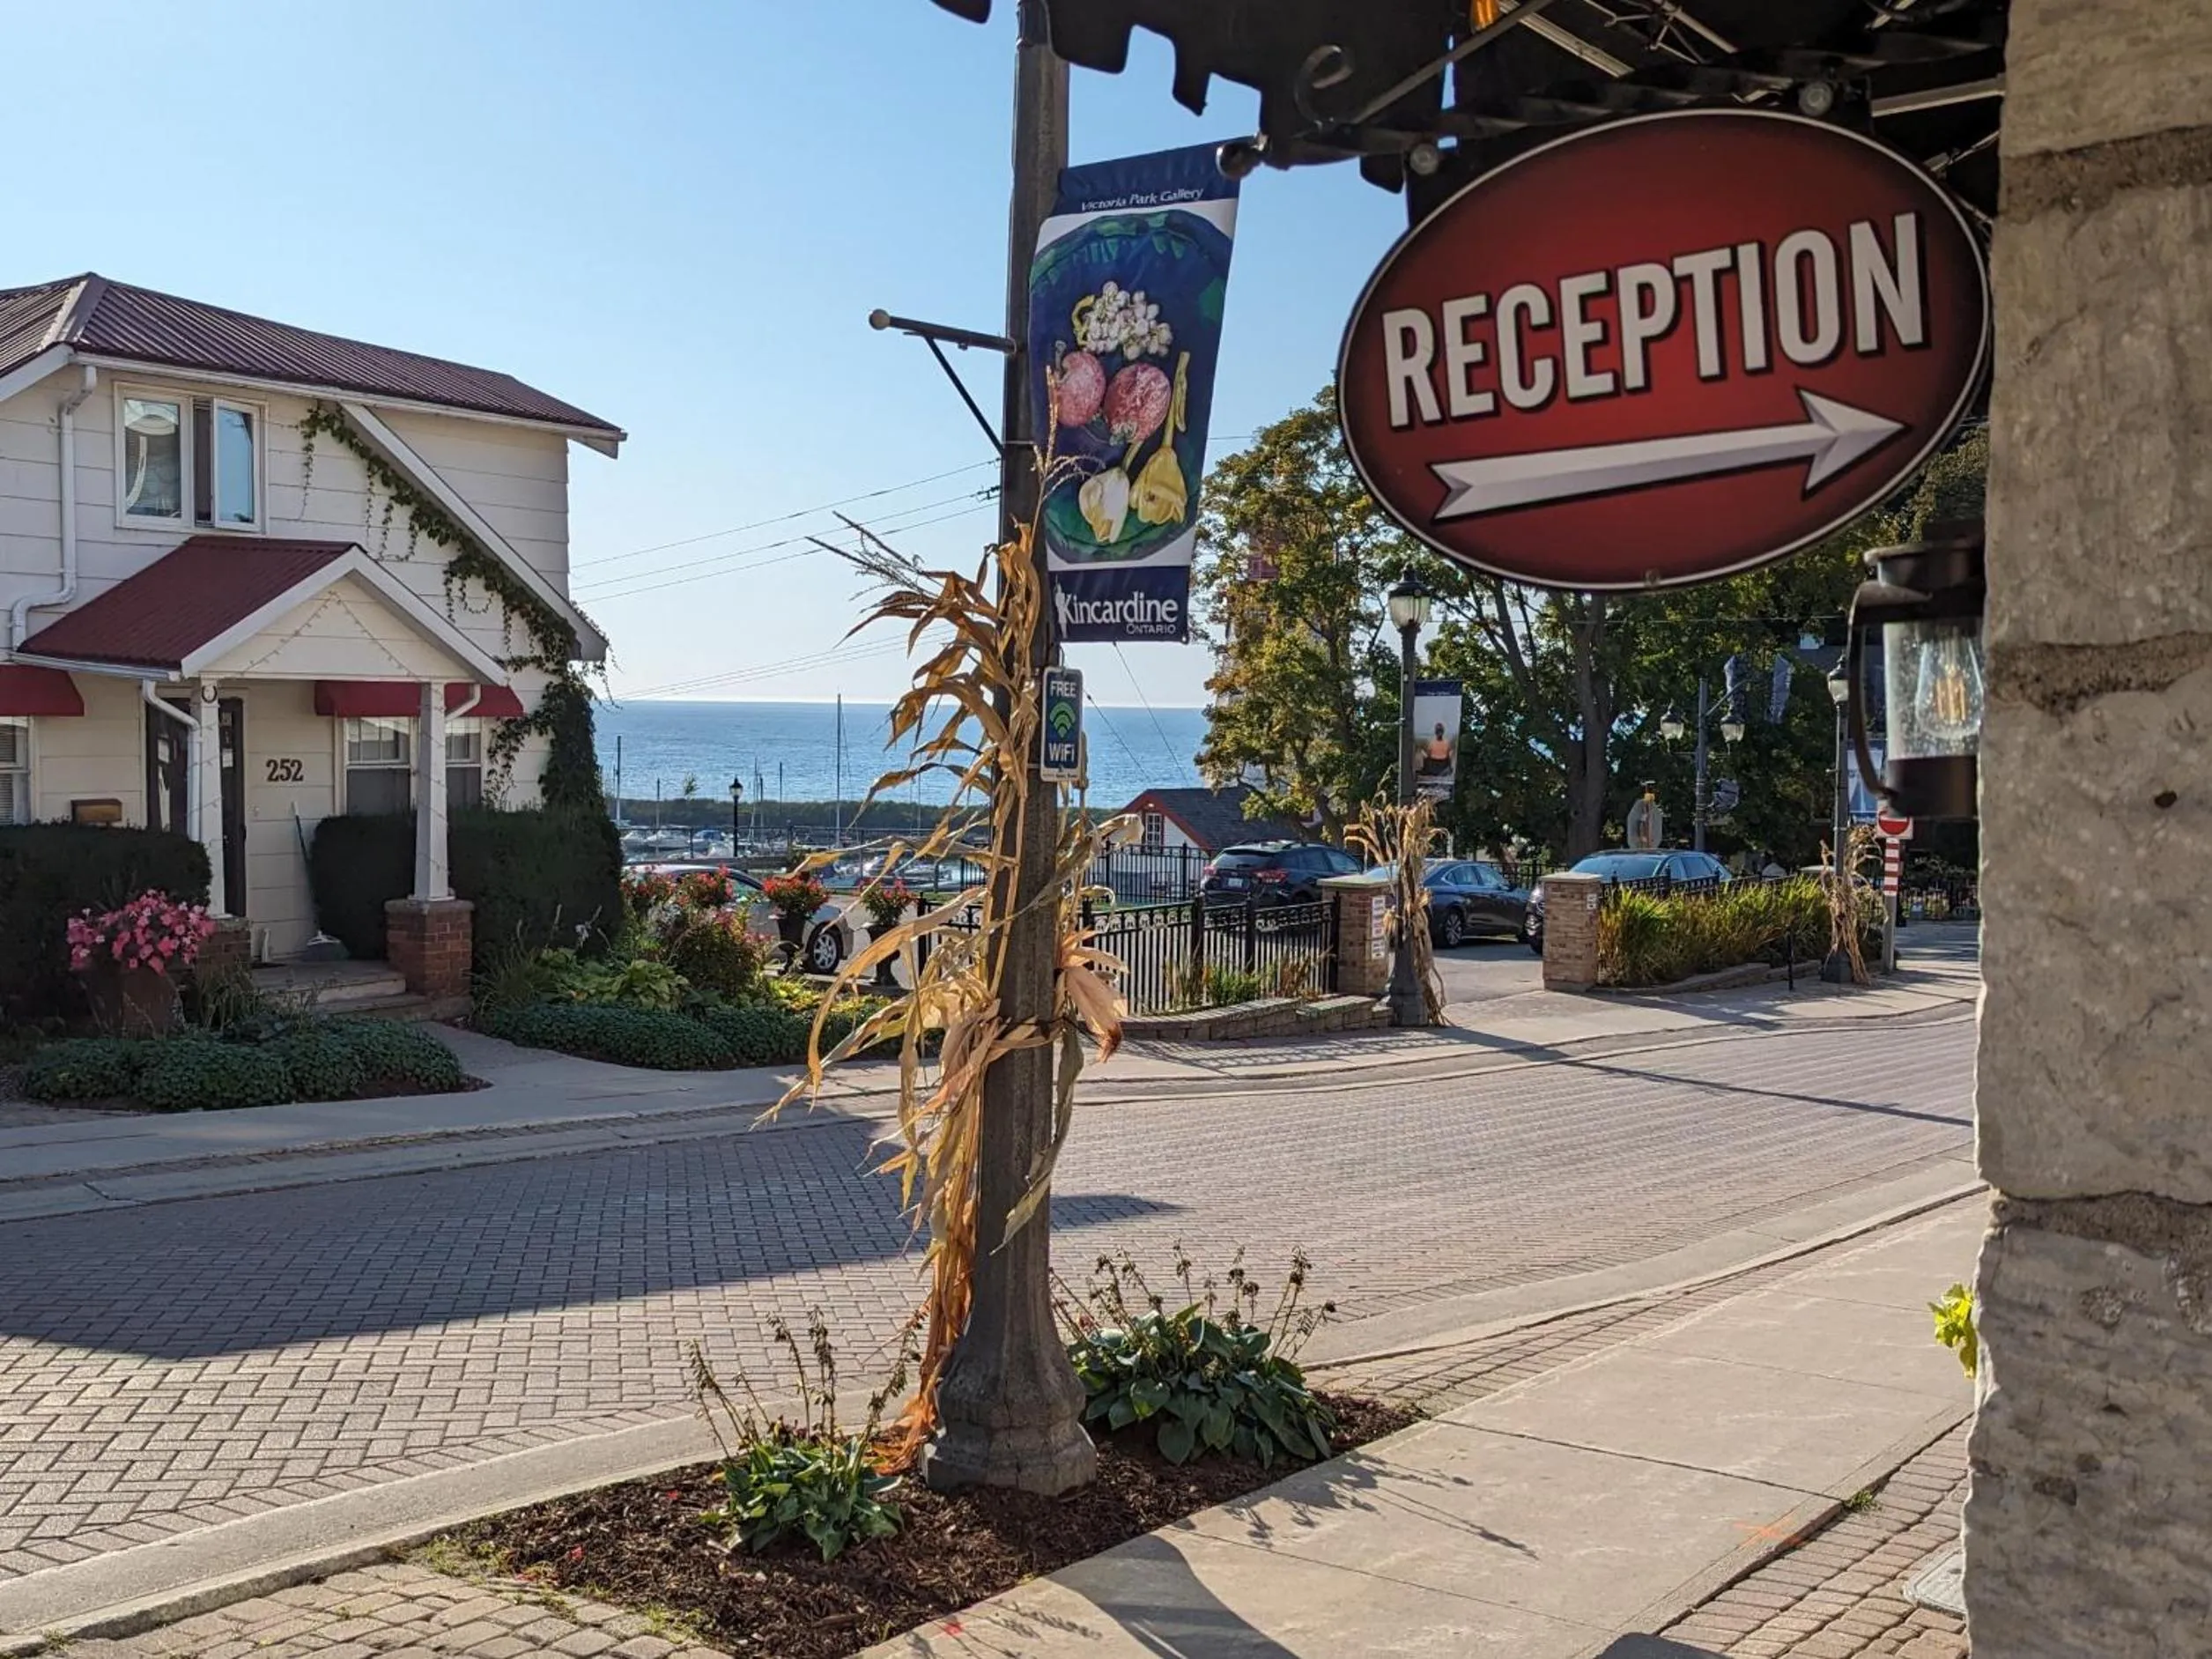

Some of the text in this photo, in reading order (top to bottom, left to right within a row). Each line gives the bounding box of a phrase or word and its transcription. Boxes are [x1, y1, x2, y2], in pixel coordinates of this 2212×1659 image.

[1082, 188, 1204, 211] Victoria Park Gallery
[1381, 211, 1924, 428] RECEPTION
[1056, 588, 1179, 626] Kincardine
[1126, 624, 1176, 635] ONTARIO
[1050, 680, 1076, 698] FREE
[1048, 743, 1075, 762] WiFi
[266, 759, 304, 782] 252
